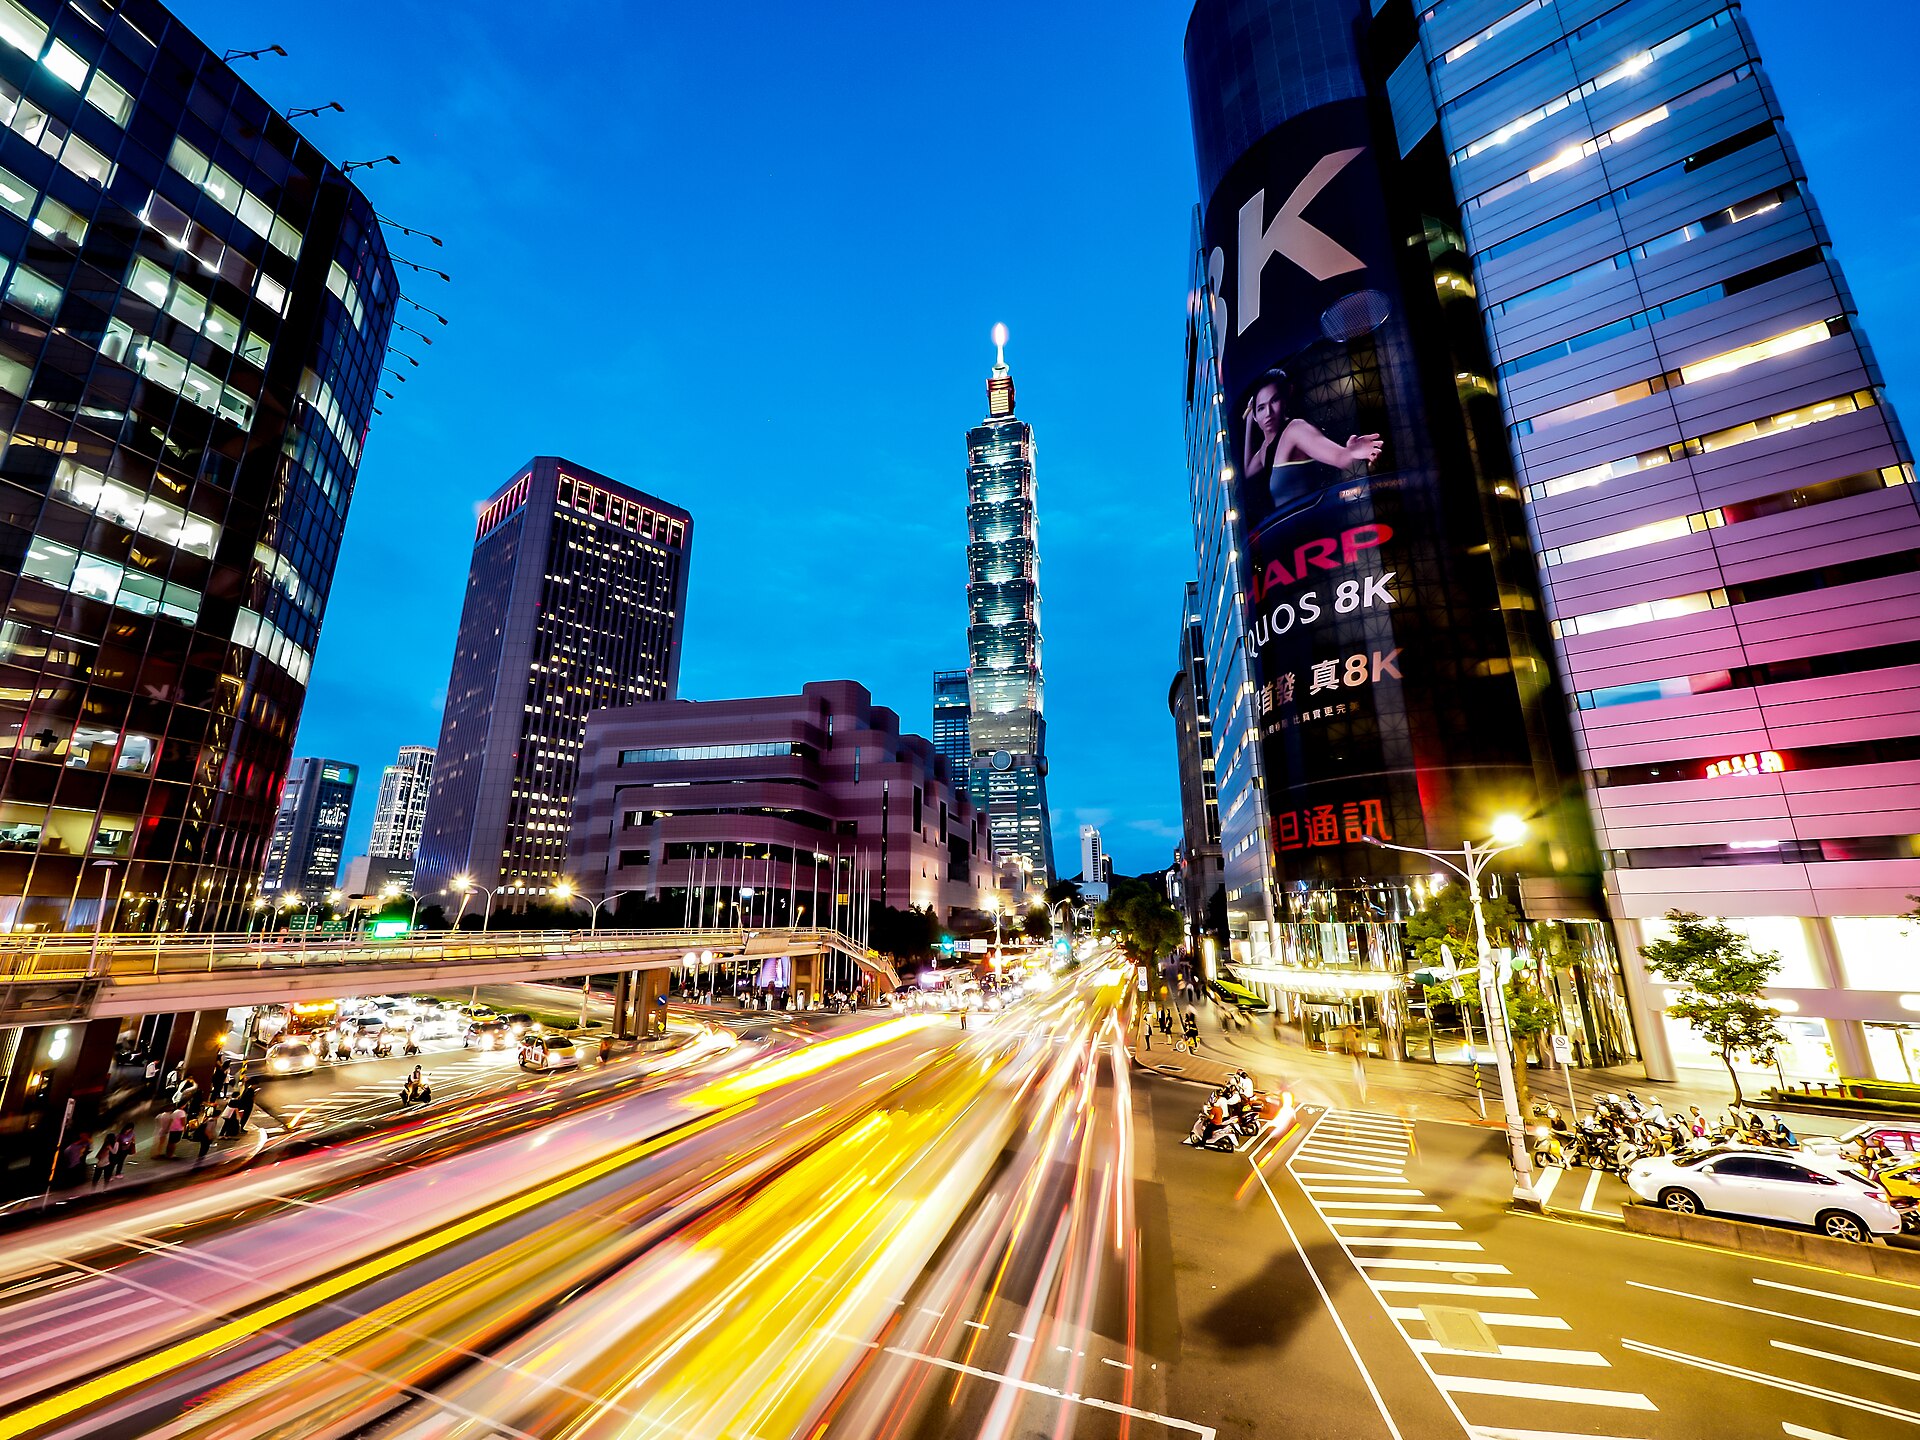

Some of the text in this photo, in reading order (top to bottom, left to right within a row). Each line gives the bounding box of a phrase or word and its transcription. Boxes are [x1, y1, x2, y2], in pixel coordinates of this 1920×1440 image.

[1247, 571, 1397, 658] QUOS 8K
[1310, 647, 1404, 696] 真8K
